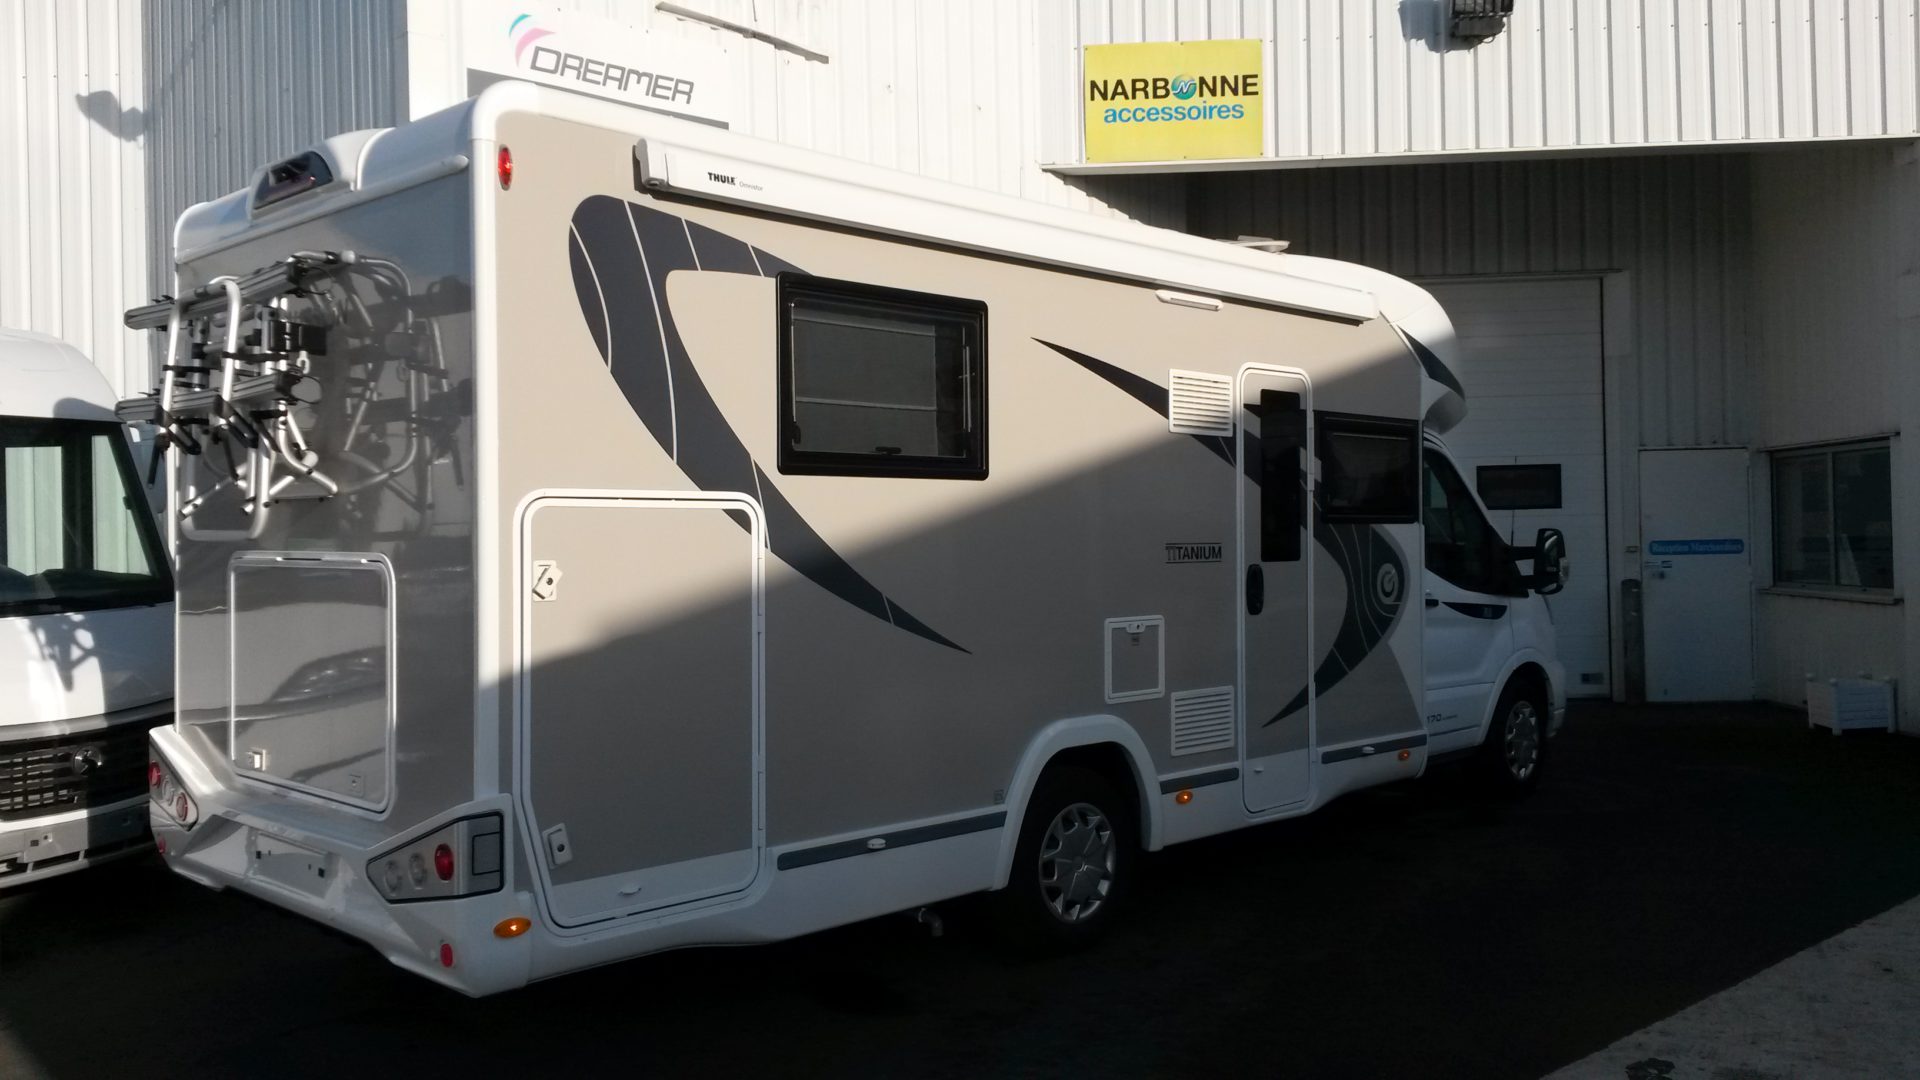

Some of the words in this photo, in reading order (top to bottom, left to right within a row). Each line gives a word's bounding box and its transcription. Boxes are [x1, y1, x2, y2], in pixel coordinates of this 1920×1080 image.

[530, 46, 695, 105] DREAMER
[1103, 100, 1245, 124] accessoires
[707, 171, 736, 186] THULE
[1165, 545, 1222, 561] TITANIUM
